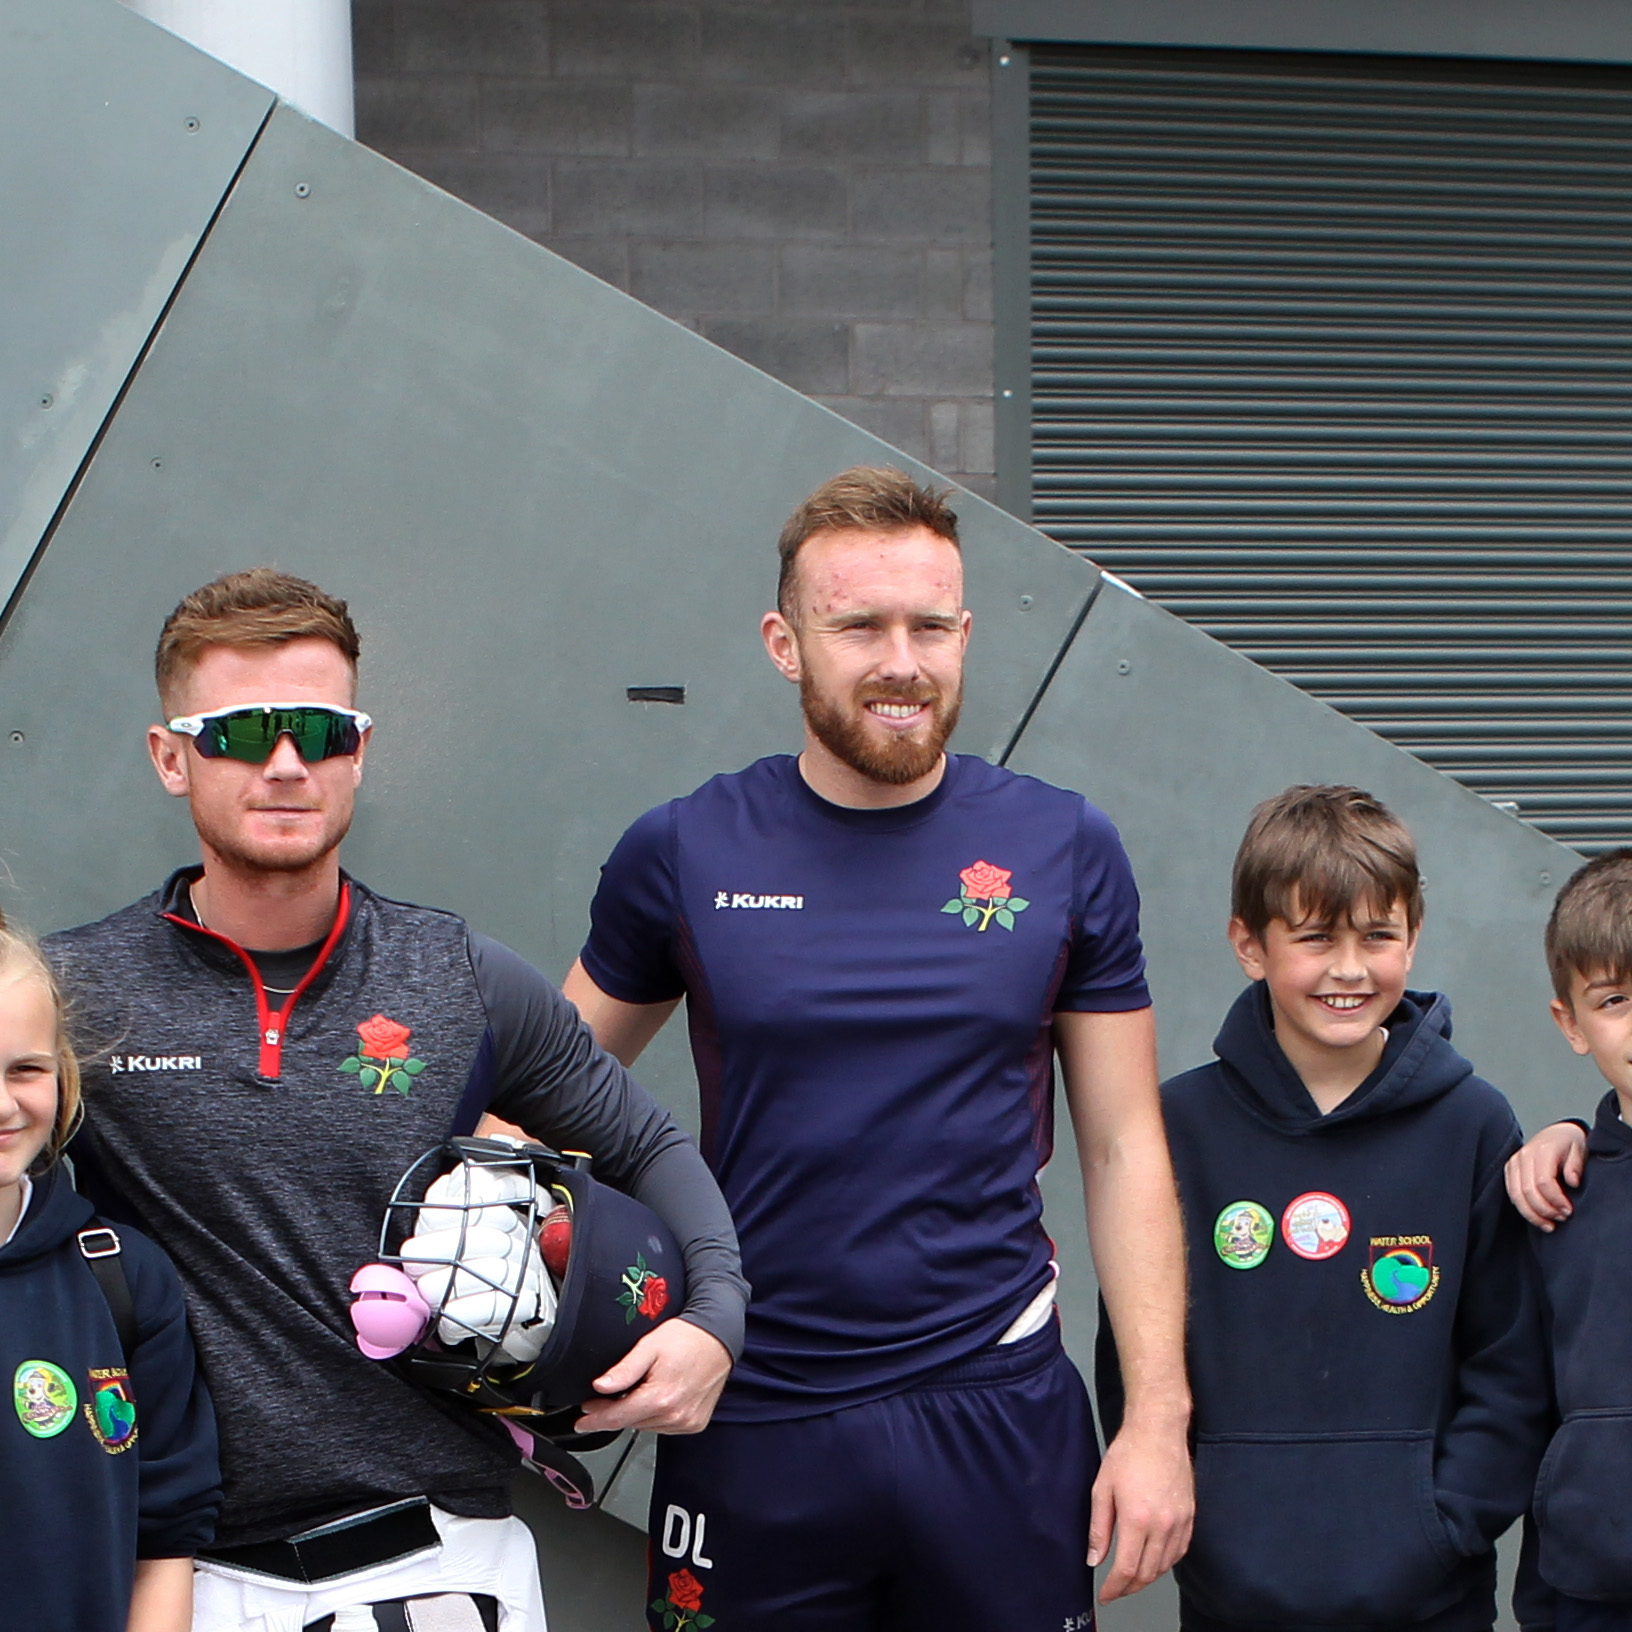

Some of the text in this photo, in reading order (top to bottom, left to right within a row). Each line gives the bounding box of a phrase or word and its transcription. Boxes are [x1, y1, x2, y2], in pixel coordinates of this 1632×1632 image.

[731, 893, 804, 909] KUKRI
[128, 1055, 202, 1072] KUKRI
[1370, 1234, 1432, 1247] WATER SCHOOL
[662, 1504, 713, 1569] DL
